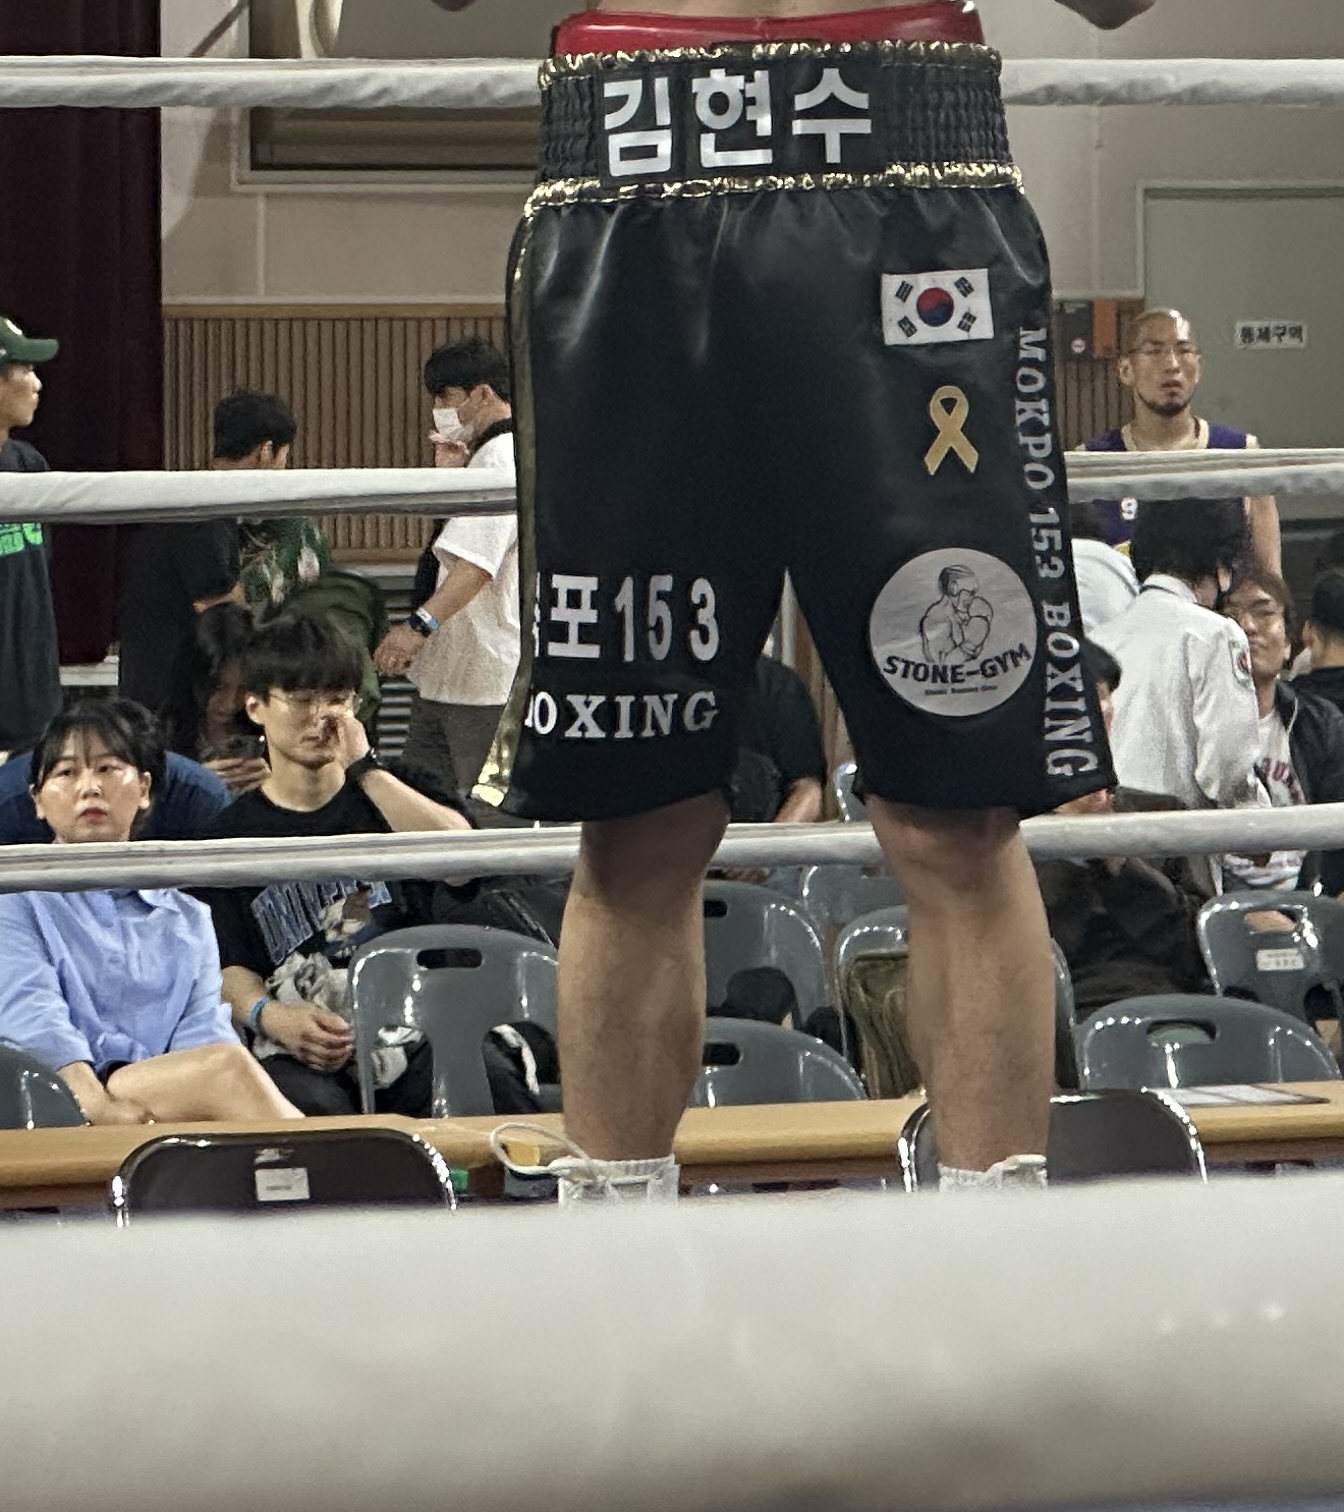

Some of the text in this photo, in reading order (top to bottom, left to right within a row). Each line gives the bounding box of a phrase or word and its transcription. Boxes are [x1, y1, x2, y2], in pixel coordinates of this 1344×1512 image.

[602, 67, 873, 178] 김현수
[1014, 326, 1099, 777] MOKPO 153 BOXING
[883, 642, 1032, 684] STONE-GYM
[525, 690, 719, 739] OXING
